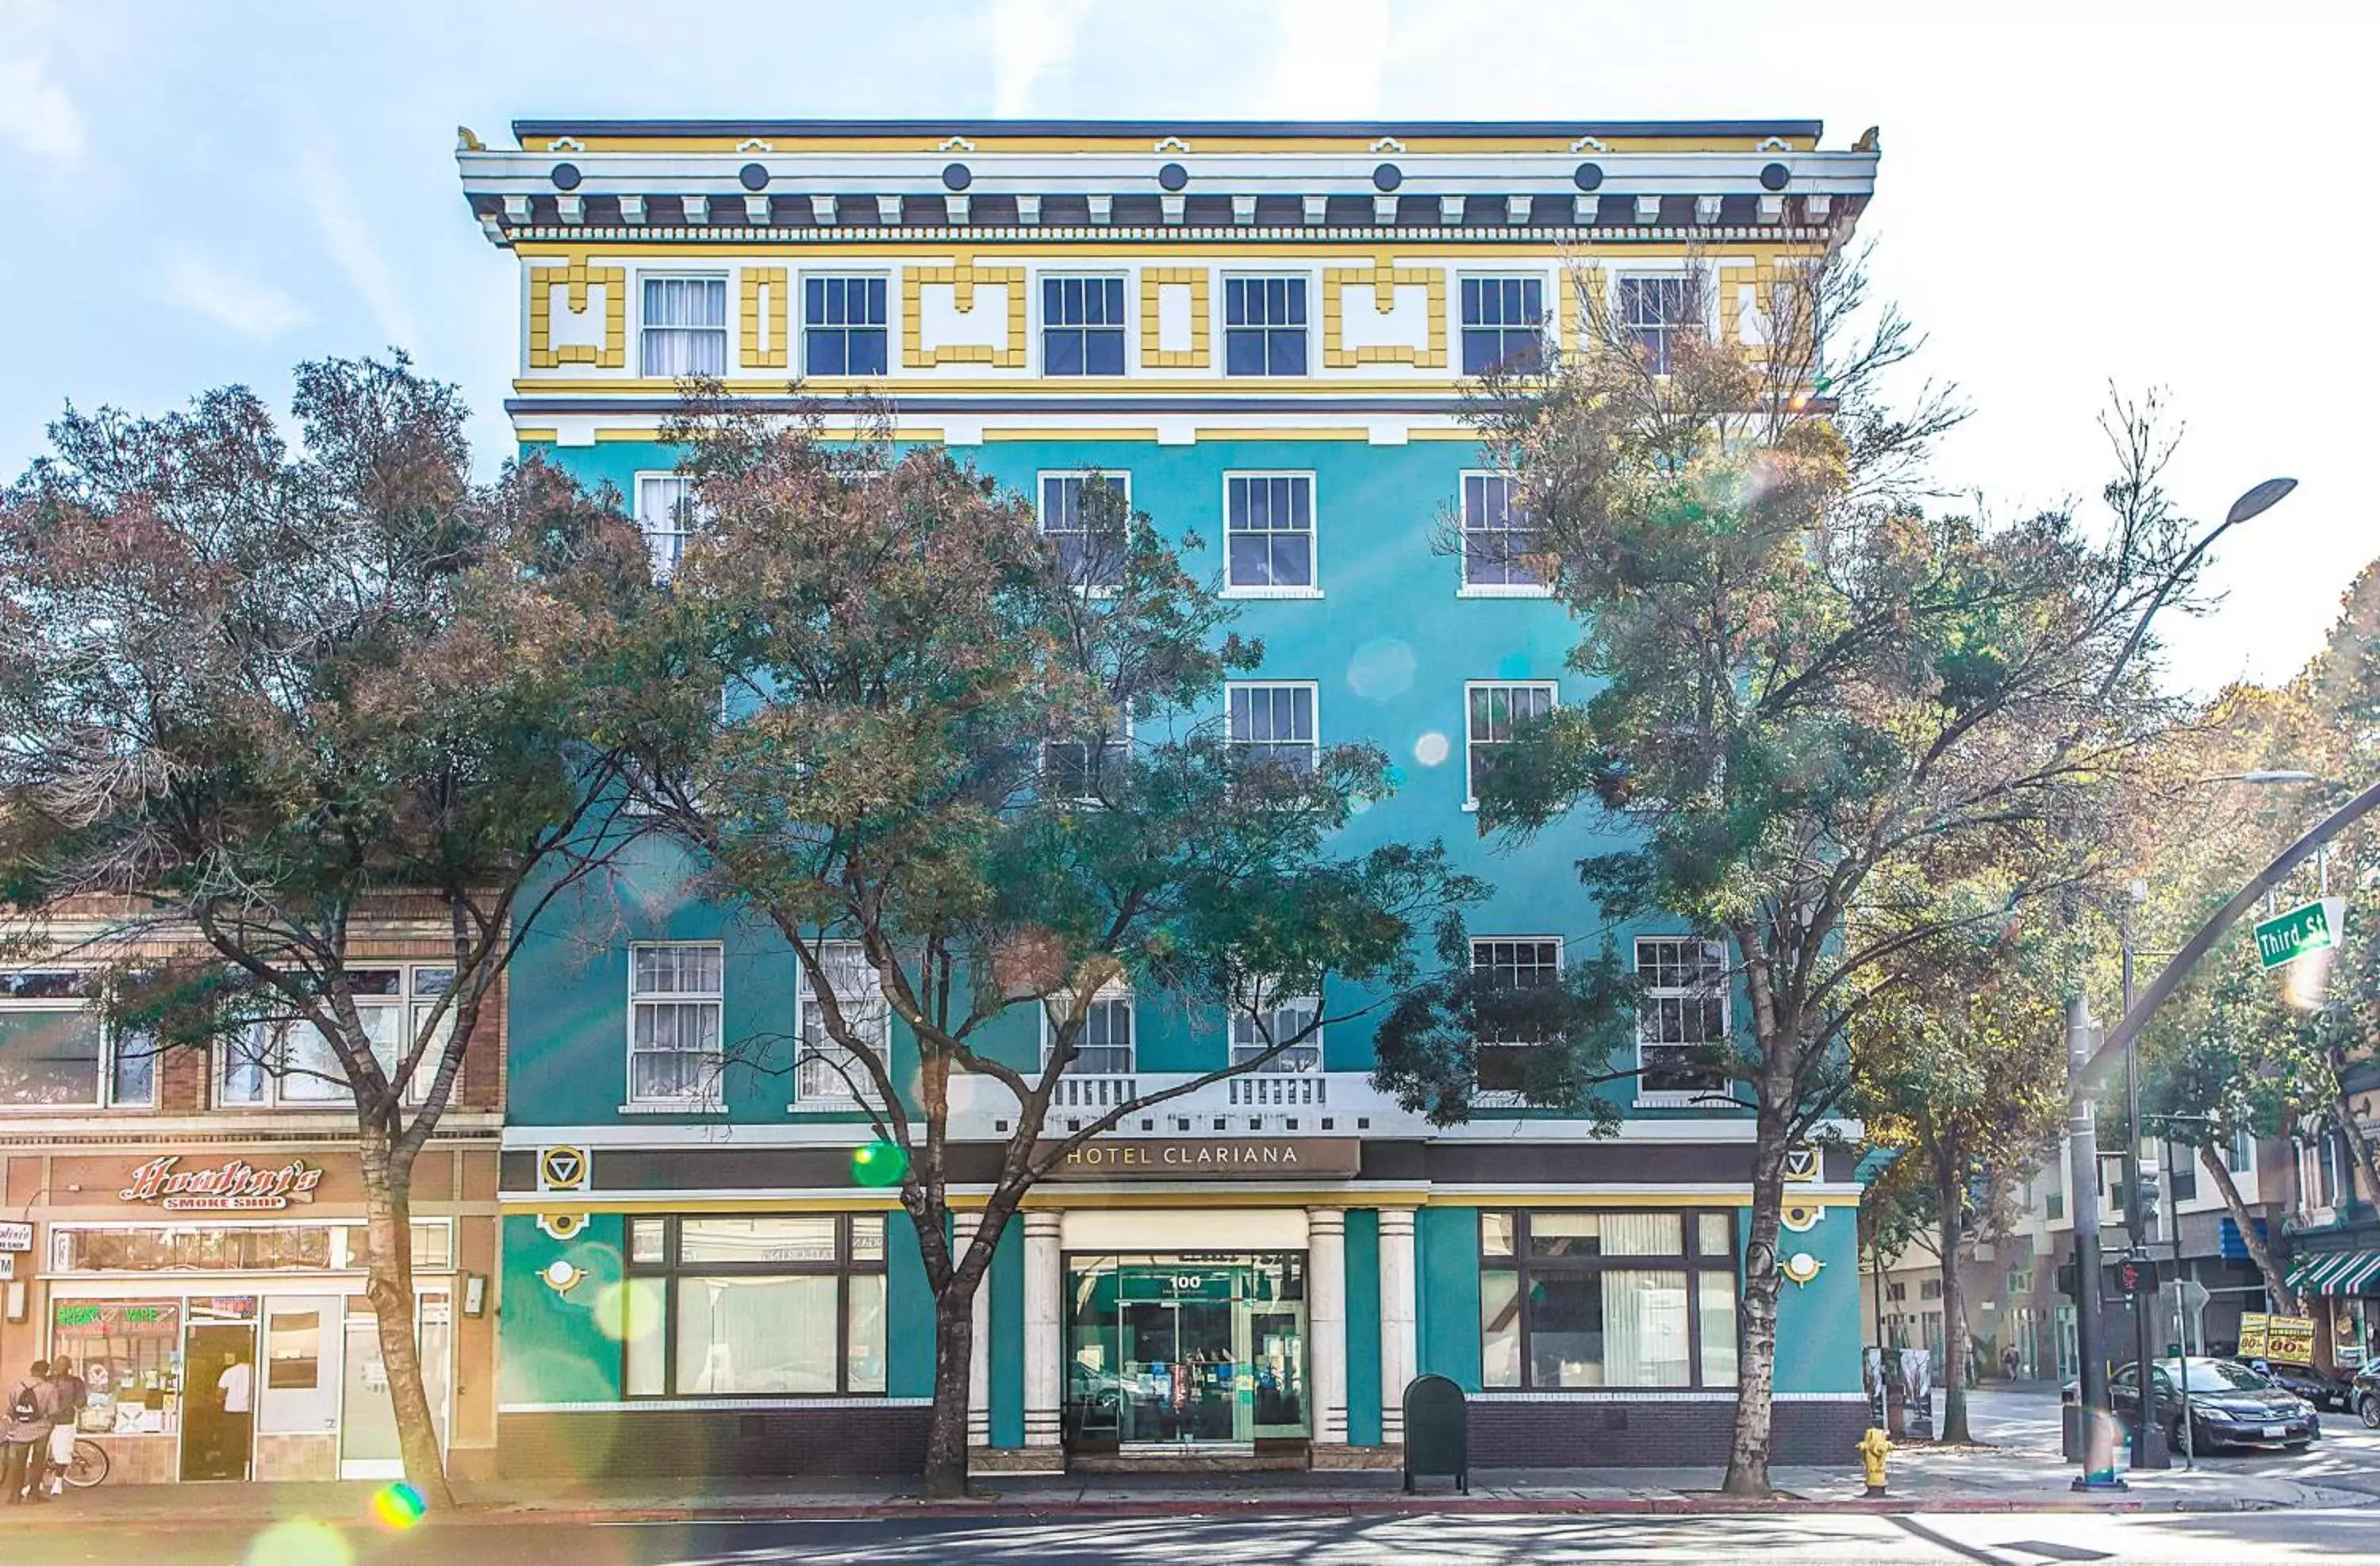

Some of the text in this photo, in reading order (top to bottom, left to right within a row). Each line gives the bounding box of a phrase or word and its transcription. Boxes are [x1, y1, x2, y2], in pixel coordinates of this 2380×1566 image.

[2259, 914, 2324, 957] Third St
[1067, 1146, 1298, 1164] HOTEL CLARIANA
[167, 1199, 280, 1207] SMOKE SHOP
[1169, 1276, 1200, 1288] 100
[125, 1307, 159, 1321] VAPE
